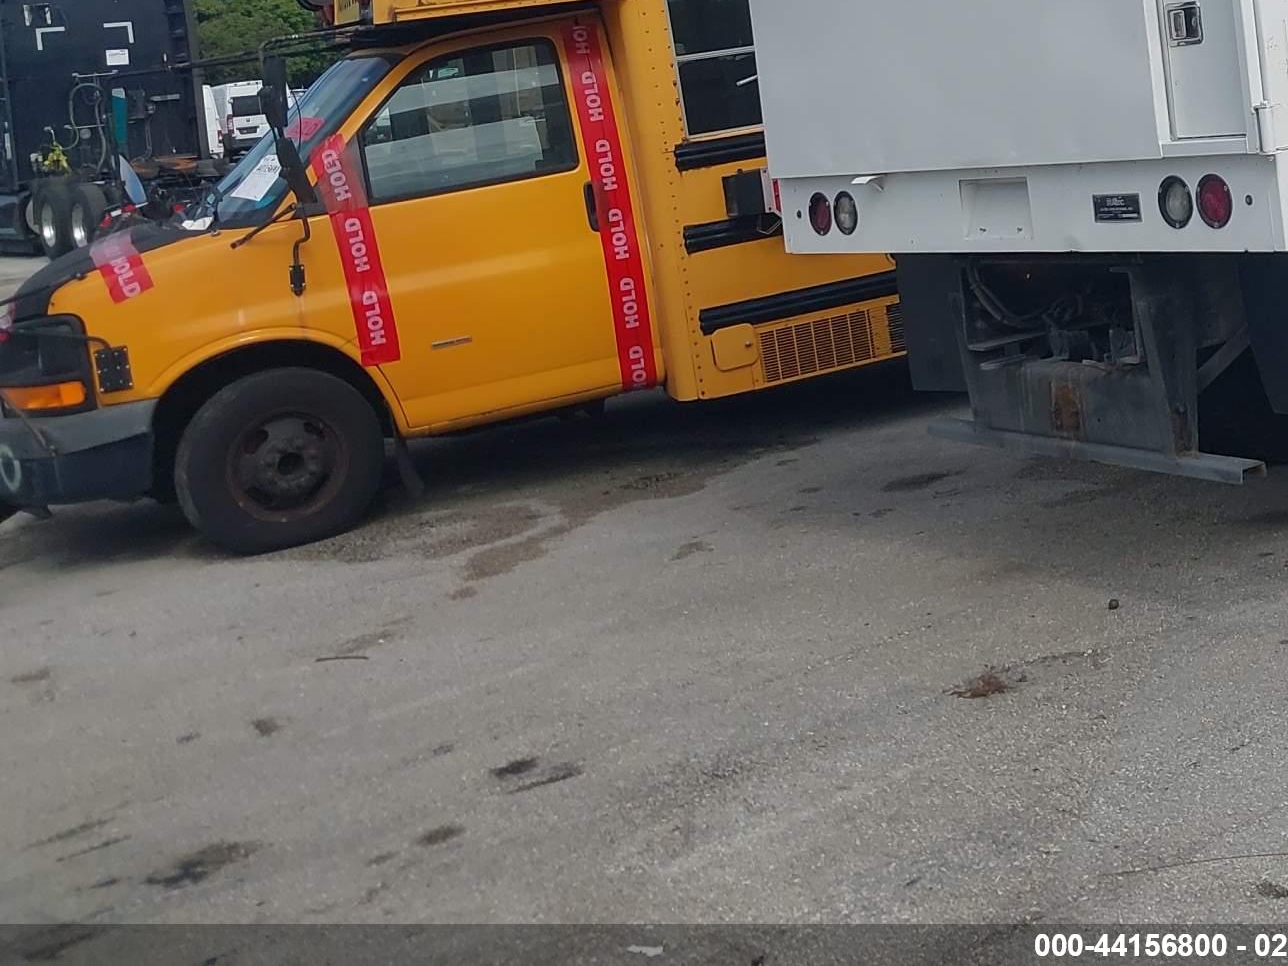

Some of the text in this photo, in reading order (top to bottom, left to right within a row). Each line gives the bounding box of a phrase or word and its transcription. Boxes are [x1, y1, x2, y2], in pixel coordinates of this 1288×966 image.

[581, 71, 604, 122] HOLD
[595, 139, 618, 191] HOLD
[321, 148, 386, 346] HOLD HOLD HOLD
[608, 208, 630, 260] HOLD
[619, 276, 640, 329] HOLD
